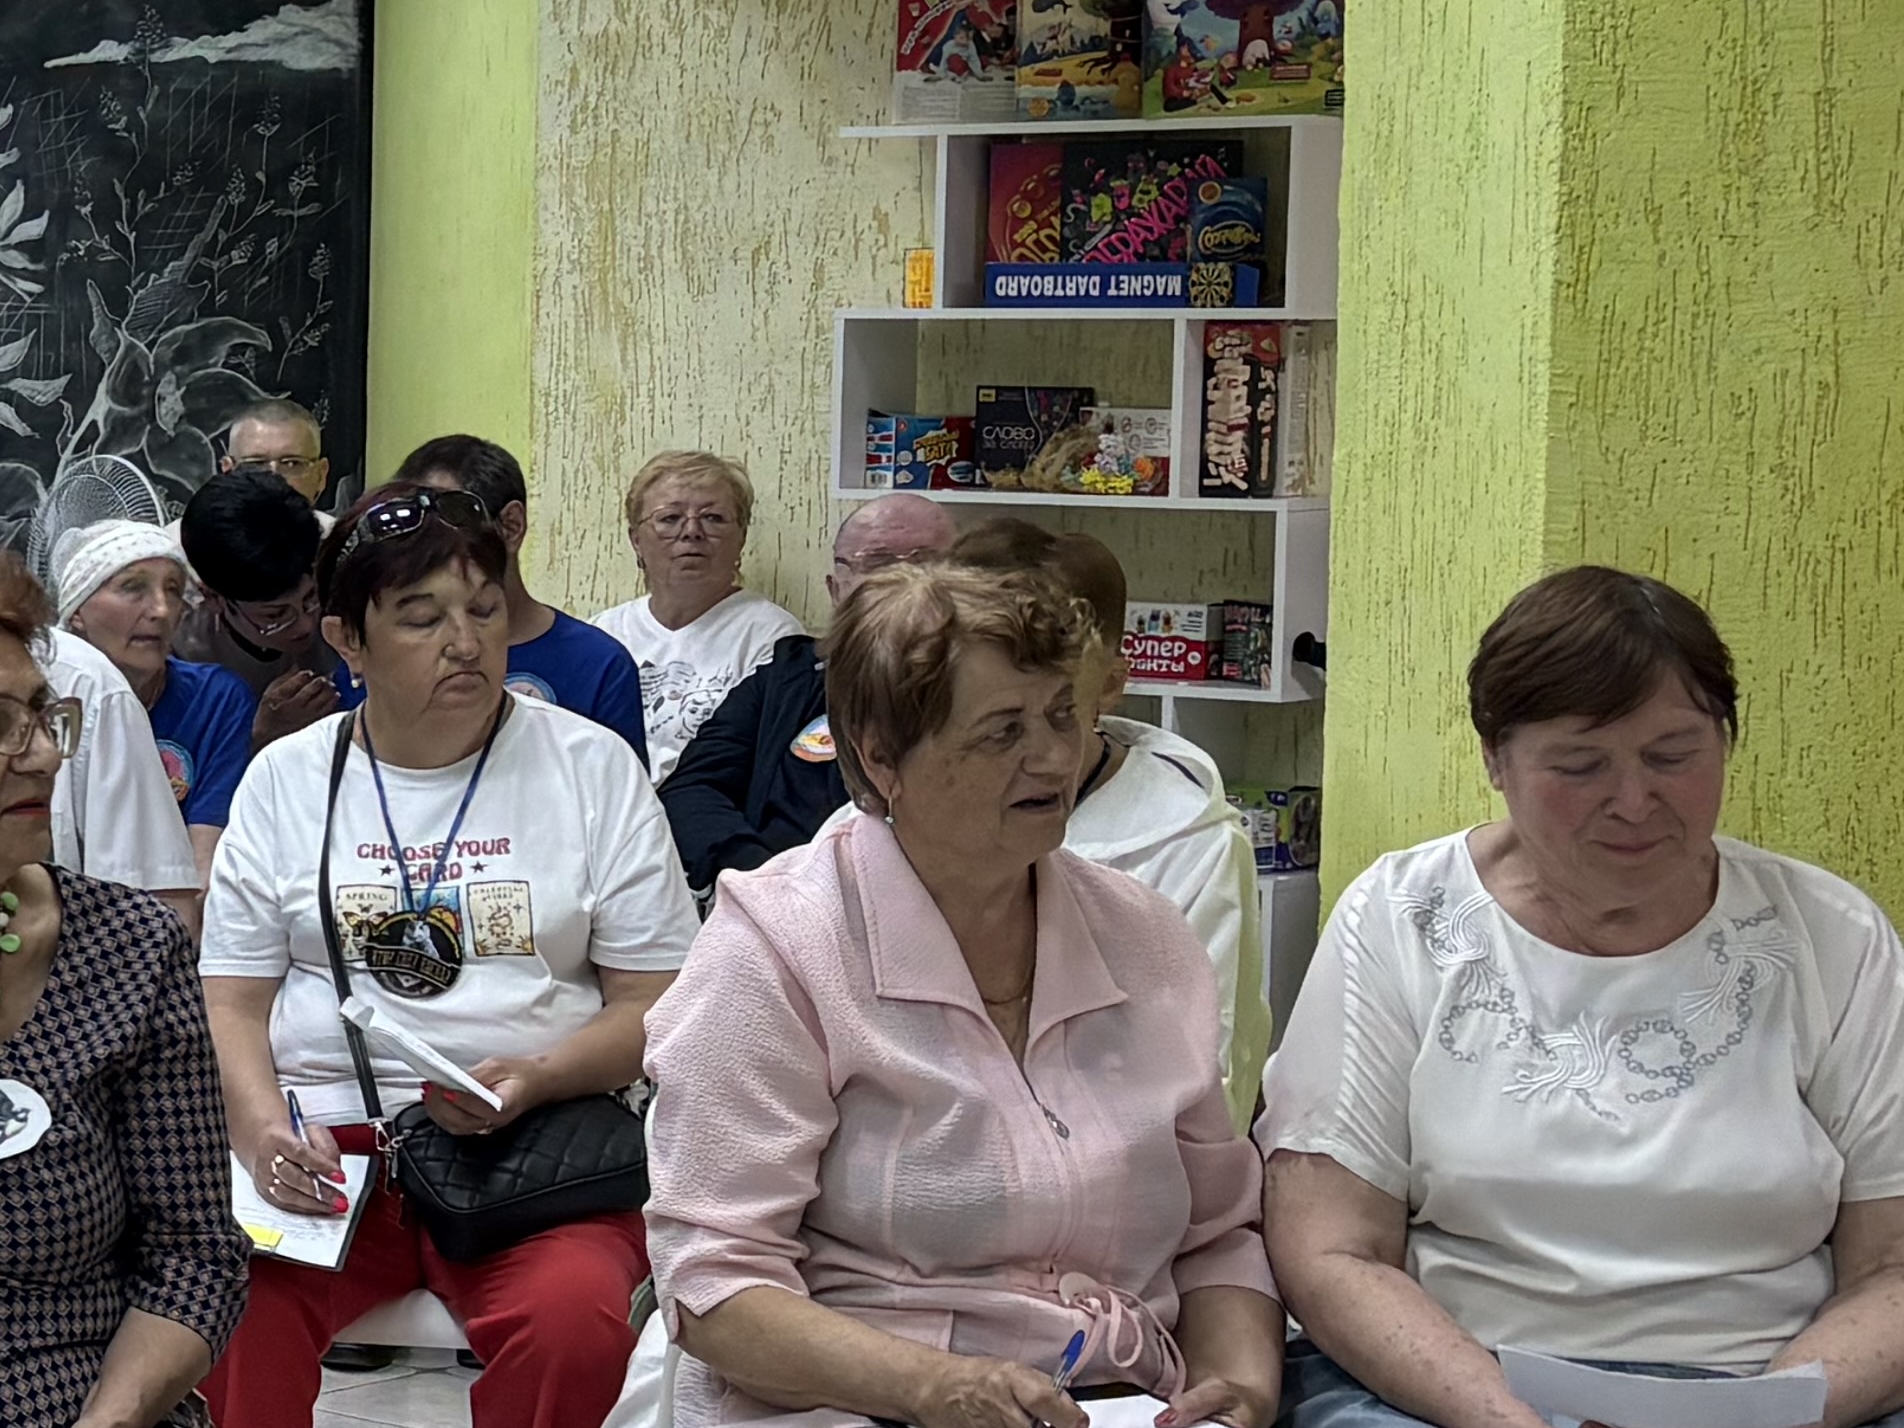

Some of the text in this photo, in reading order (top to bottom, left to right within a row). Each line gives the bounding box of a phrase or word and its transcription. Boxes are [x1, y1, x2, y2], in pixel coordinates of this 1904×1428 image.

[995, 274, 1182, 297] MAGNET DARTBOARD
[1120, 635, 1187, 657] Супер
[455, 837, 511, 858] YOUR
